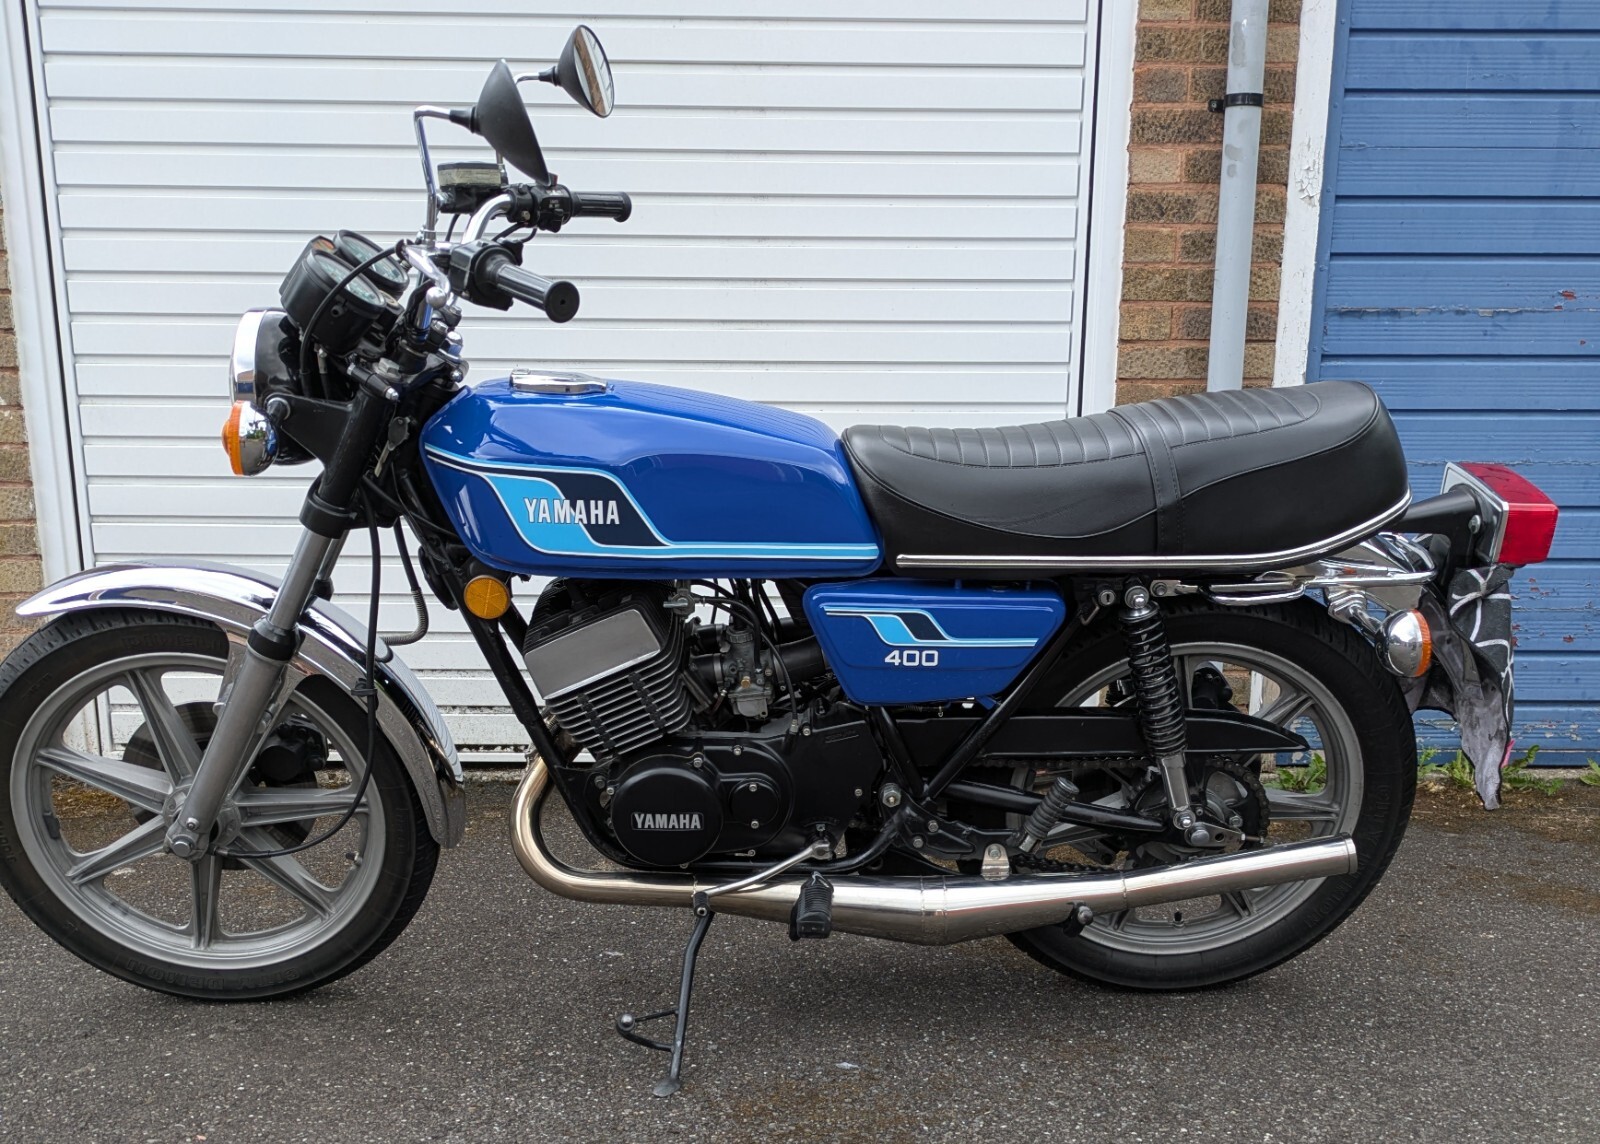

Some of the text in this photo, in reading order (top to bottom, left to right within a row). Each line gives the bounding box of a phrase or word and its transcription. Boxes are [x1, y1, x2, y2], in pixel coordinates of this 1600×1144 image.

[524, 497, 621, 525] YAMAHA
[884, 649, 939, 667] 400
[634, 813, 701, 829] YAMAHA
